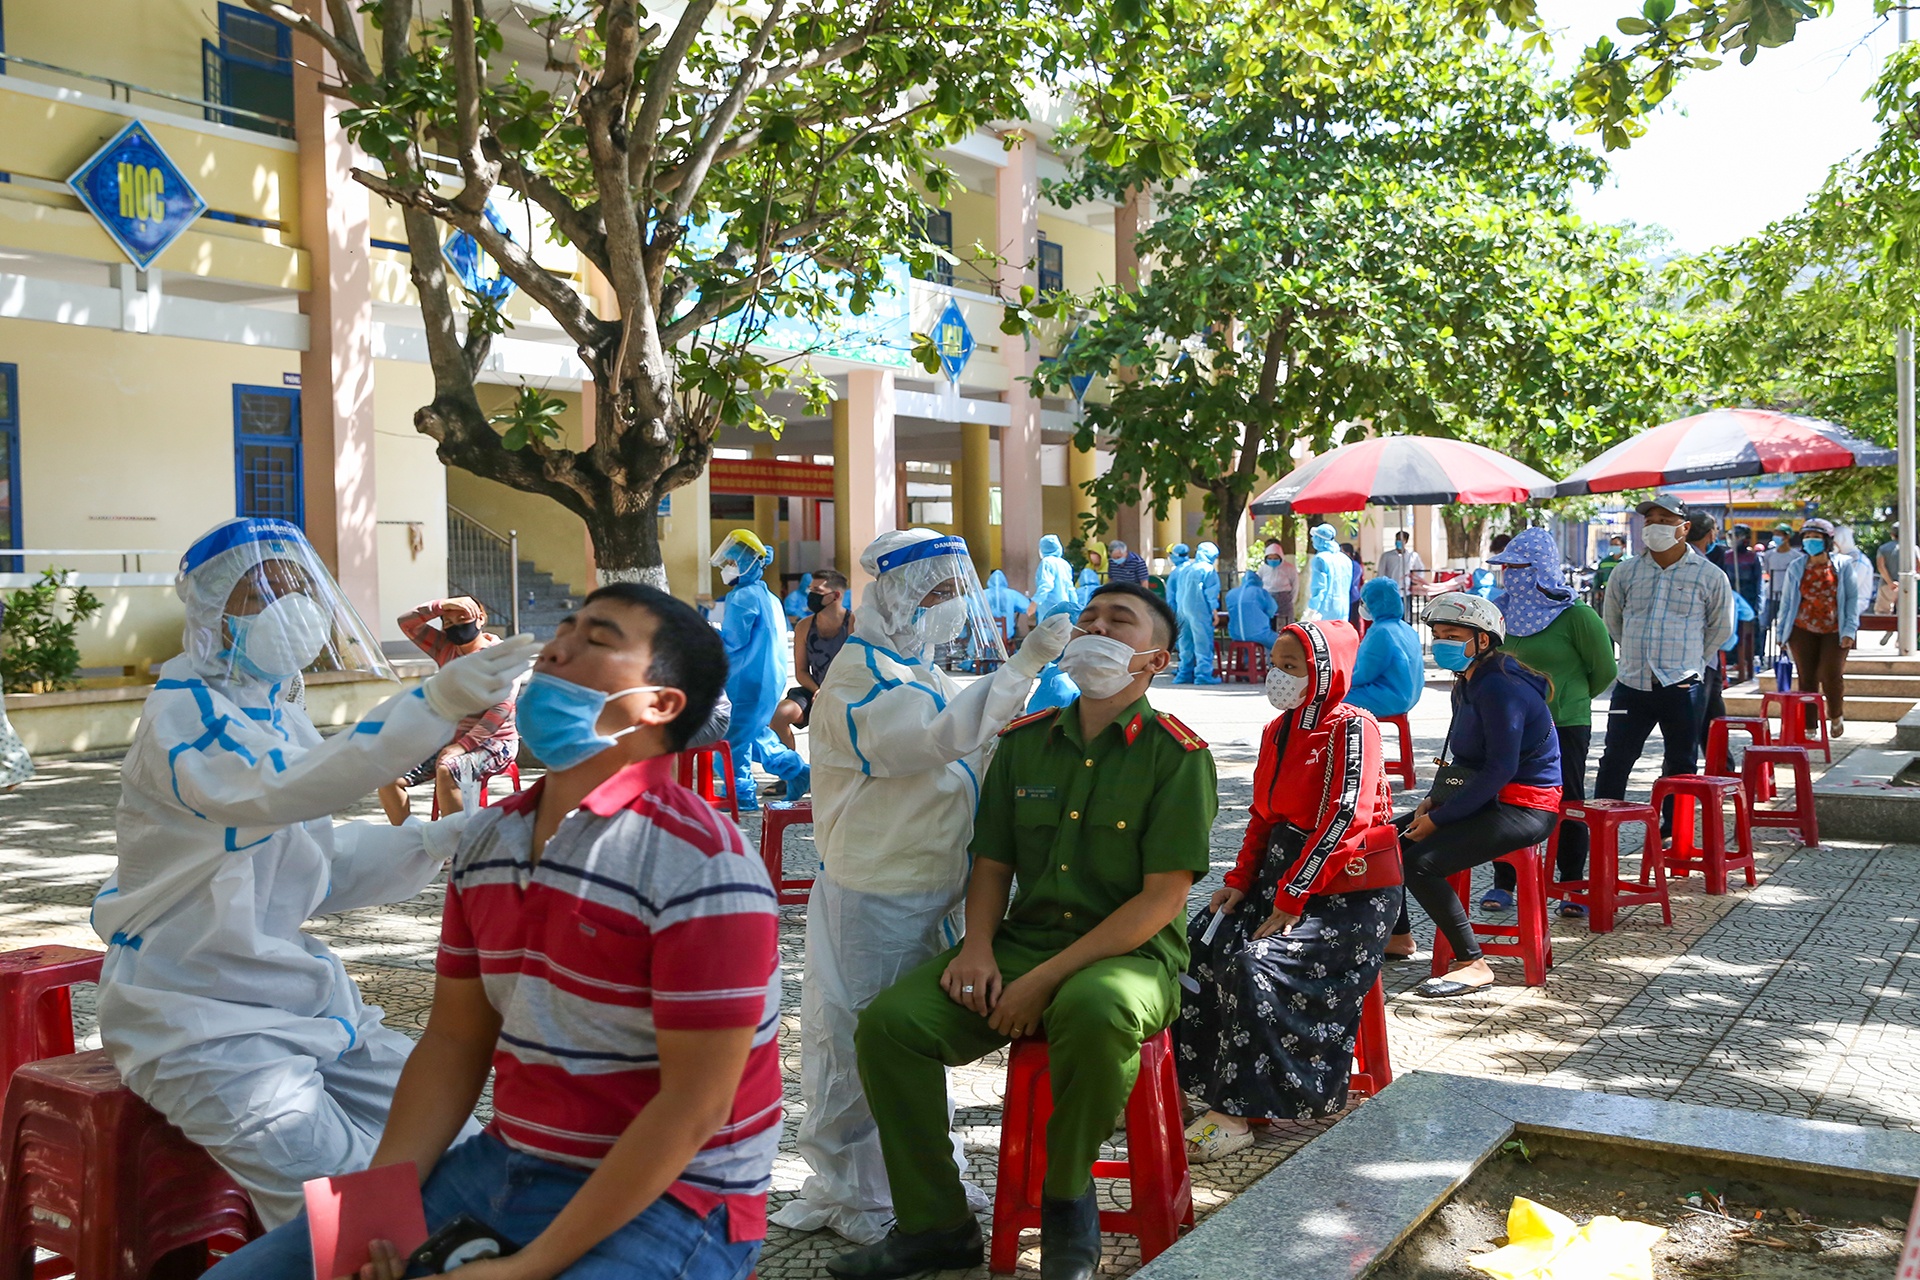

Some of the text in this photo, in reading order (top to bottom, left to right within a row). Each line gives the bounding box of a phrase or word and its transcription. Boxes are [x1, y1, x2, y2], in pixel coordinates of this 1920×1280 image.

[117, 161, 165, 232] HỌC
[1319, 670, 1330, 695] PUMA
[1302, 704, 1317, 730] PUMA
[1349, 733, 1361, 761] PUMA
[1326, 818, 1347, 843] PUMA
[1301, 855, 1322, 881] PUMA
